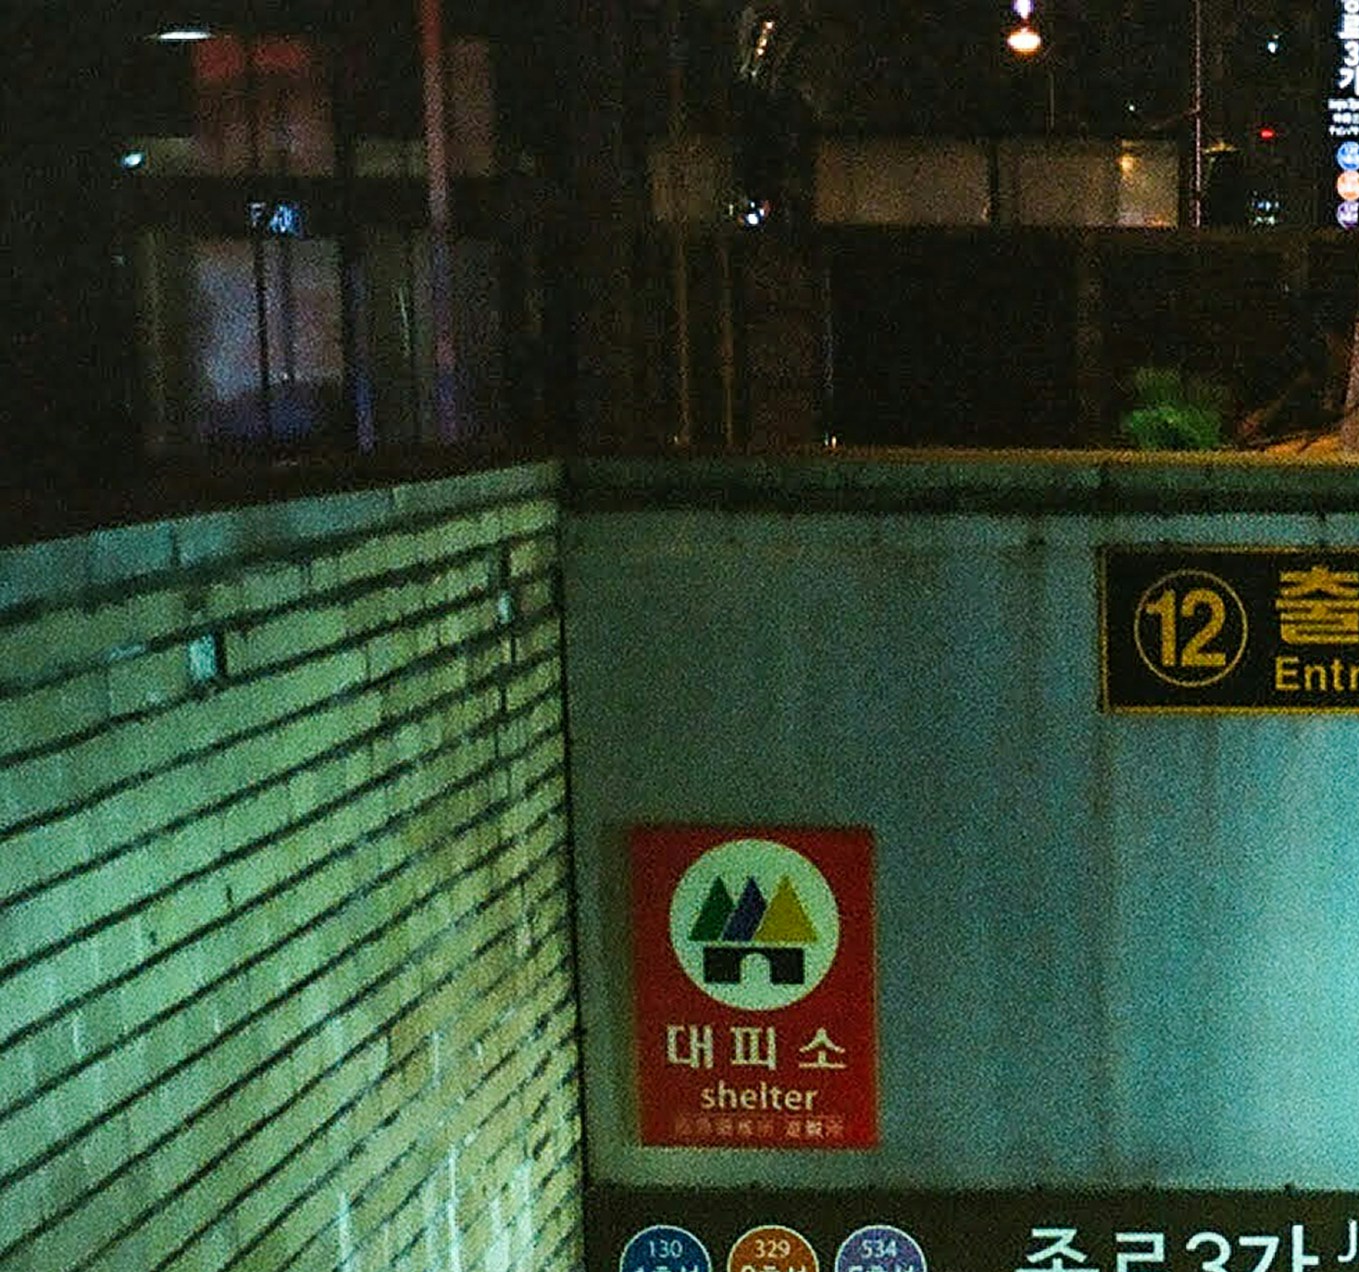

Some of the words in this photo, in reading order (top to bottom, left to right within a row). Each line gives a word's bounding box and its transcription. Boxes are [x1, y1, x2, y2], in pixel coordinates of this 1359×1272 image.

[1145, 588, 1226, 668] 12
[665, 1024, 847, 1070] 대피소
[700, 1080, 818, 1110] shelter
[648, 1239, 683, 1259] 130
[754, 1239, 790, 1259] 329
[860, 1239, 897, 1259] 534
